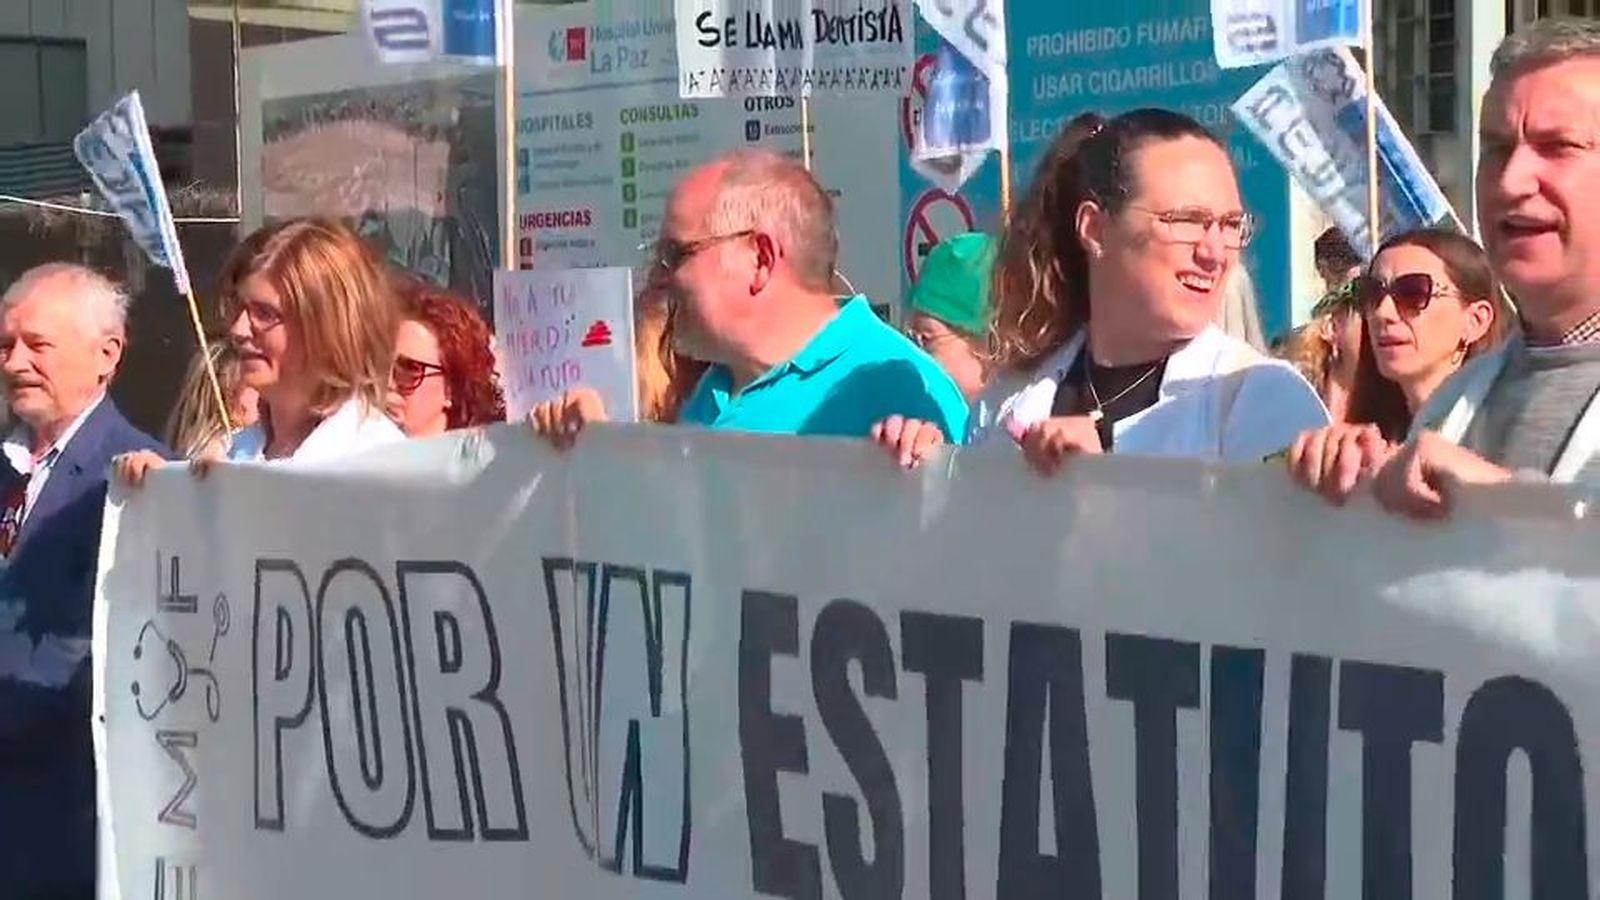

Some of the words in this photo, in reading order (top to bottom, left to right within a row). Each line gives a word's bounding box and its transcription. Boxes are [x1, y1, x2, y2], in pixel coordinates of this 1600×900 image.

[696, 10, 738, 47] SE
[1026, 26, 1132, 57] PROHIBIDO
[1137, 16, 1208, 46] FUMAR
[590, 48, 613, 73] La
[617, 45, 650, 70] Paz
[1033, 72, 1083, 99] USAR
[620, 103, 699, 126] CONSULTAS
[744, 95, 795, 113] OTROS
[519, 209, 592, 230] URGENCIAS
[252, 557, 530, 842] POR
[541, 557, 692, 884] UN
[738, 588, 1592, 900] ESTATUTO
